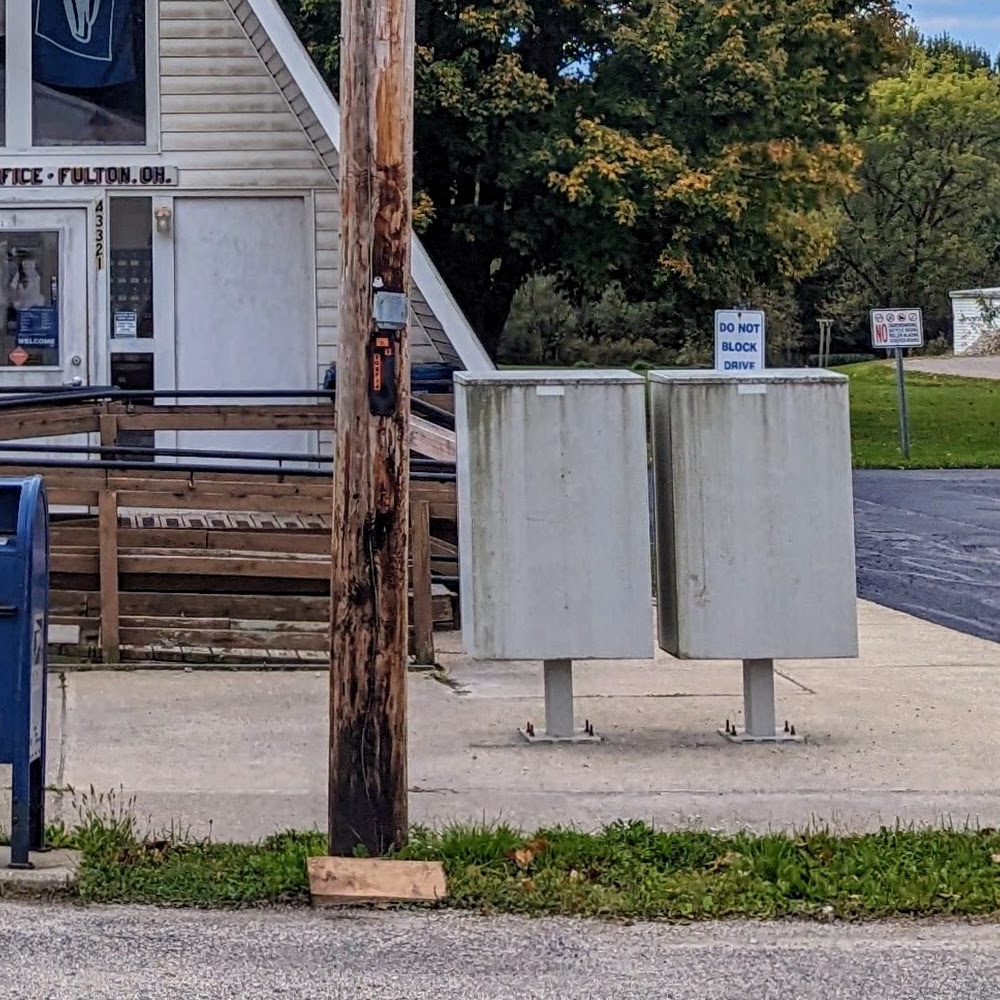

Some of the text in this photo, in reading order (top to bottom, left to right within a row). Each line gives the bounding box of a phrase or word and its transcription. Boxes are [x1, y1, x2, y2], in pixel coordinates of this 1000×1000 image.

[719, 322, 760, 333] DO NOT
[875, 323, 888, 343] NO
[722, 342, 757, 352] BLOCK
[724, 361, 755, 370] DRIVE
